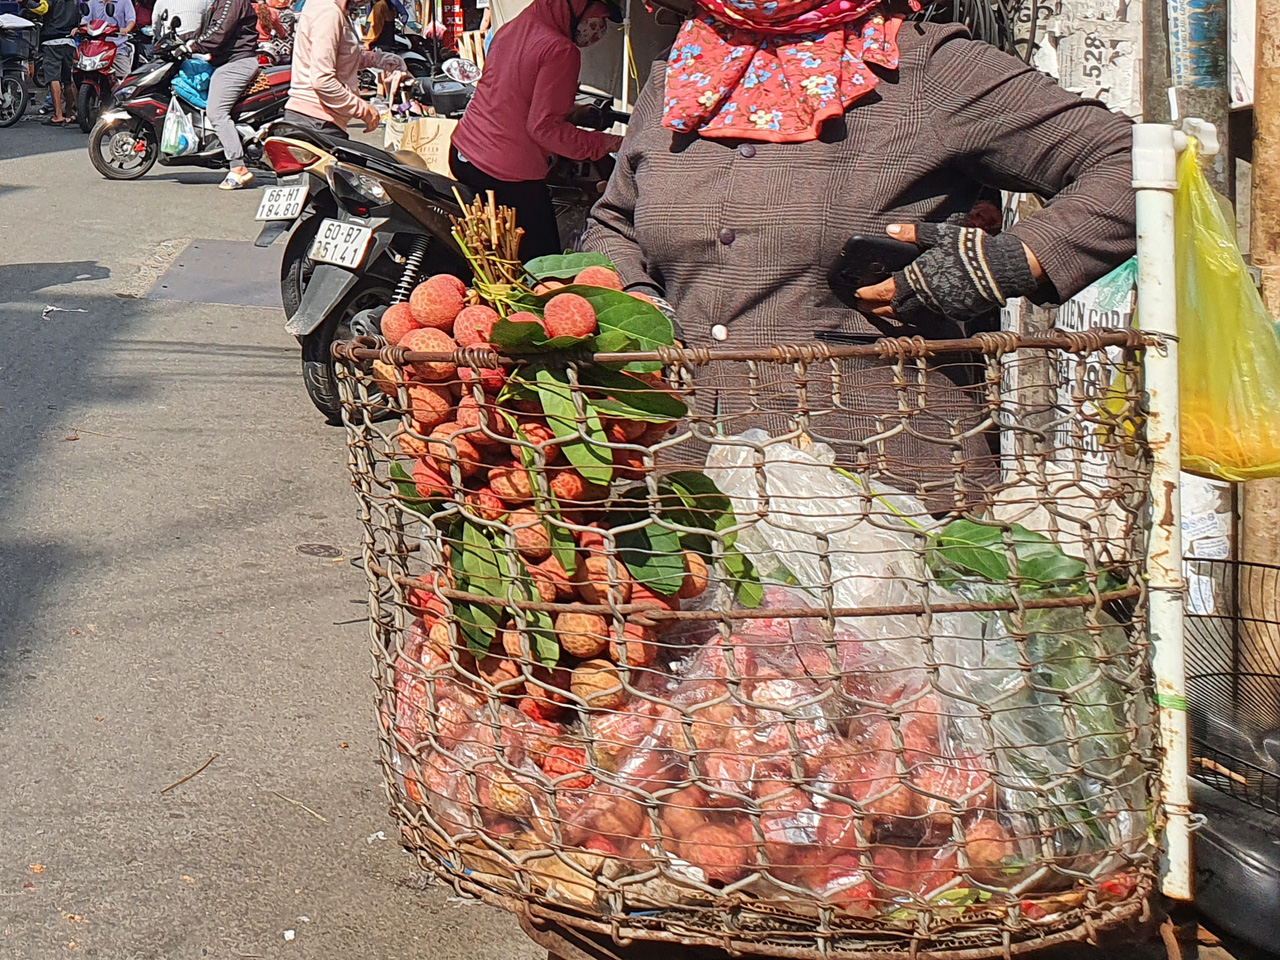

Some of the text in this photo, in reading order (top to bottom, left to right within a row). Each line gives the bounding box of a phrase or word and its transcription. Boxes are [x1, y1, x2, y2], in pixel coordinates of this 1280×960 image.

[267, 188, 300, 202] 66-H1
[259, 203, 300, 218] 184.80
[324, 223, 362, 245] 60-B7
